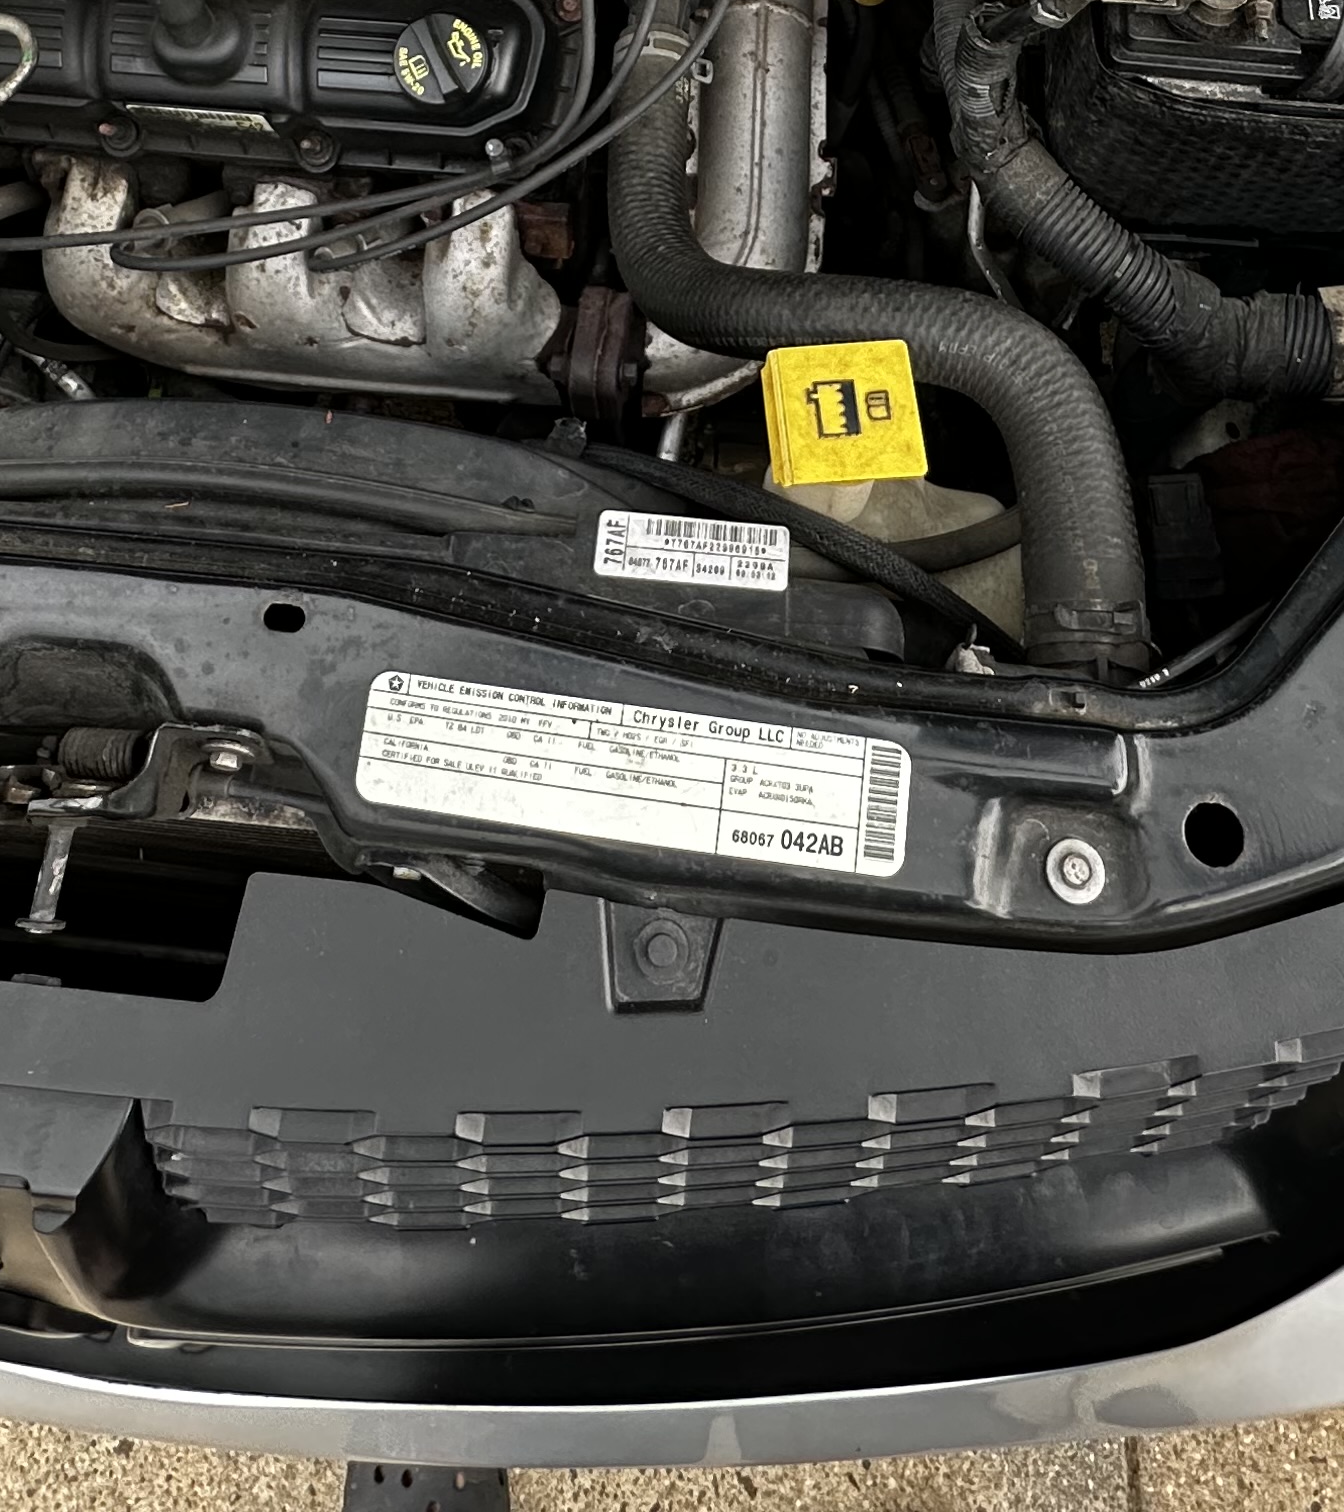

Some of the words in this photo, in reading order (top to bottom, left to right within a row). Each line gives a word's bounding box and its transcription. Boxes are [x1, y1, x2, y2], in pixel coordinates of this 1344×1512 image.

[399, 47, 409, 67] SAE
[453, 19, 481, 50] ENGINE
[471, 51, 483, 69] OIL
[400, 68, 424, 95] 5W-20
[603, 519, 626, 565] 767AF
[417, 679, 454, 693] VEHICLE
[459, 686, 504, 700] EMISSION
[508, 692, 545, 707] CONTROL
[552, 698, 612, 715] INFORMATION
[430, 703, 440, 712] TO
[443, 705, 492, 720] REGULATIONS
[409, 716, 424, 726] EPA
[470, 725, 485, 735] LDT
[533, 734, 544, 743] CA
[577, 741, 596, 751] FUEL
[609, 745, 680, 763] GASOLINE/ETHANOL
[632, 709, 700, 732] Chrysler
[708, 719, 751, 742] Group
[758, 726, 785, 744] LLC
[381, 749, 422, 763] CERTIFIED
[425, 755, 440, 766] FOR
[443, 758, 462, 769] SALE
[500, 767, 543, 781] QUALIFIED
[383, 737, 429, 752] CALIFORNIA
[529, 759, 540, 769] CA
[574, 766, 592, 777] FUEL
[605, 769, 678, 789] GASOLINE/ETHANOL
[730, 775, 754, 785] GROUP
[731, 828, 775, 848] 68067
[781, 828, 844, 858] 042AB
